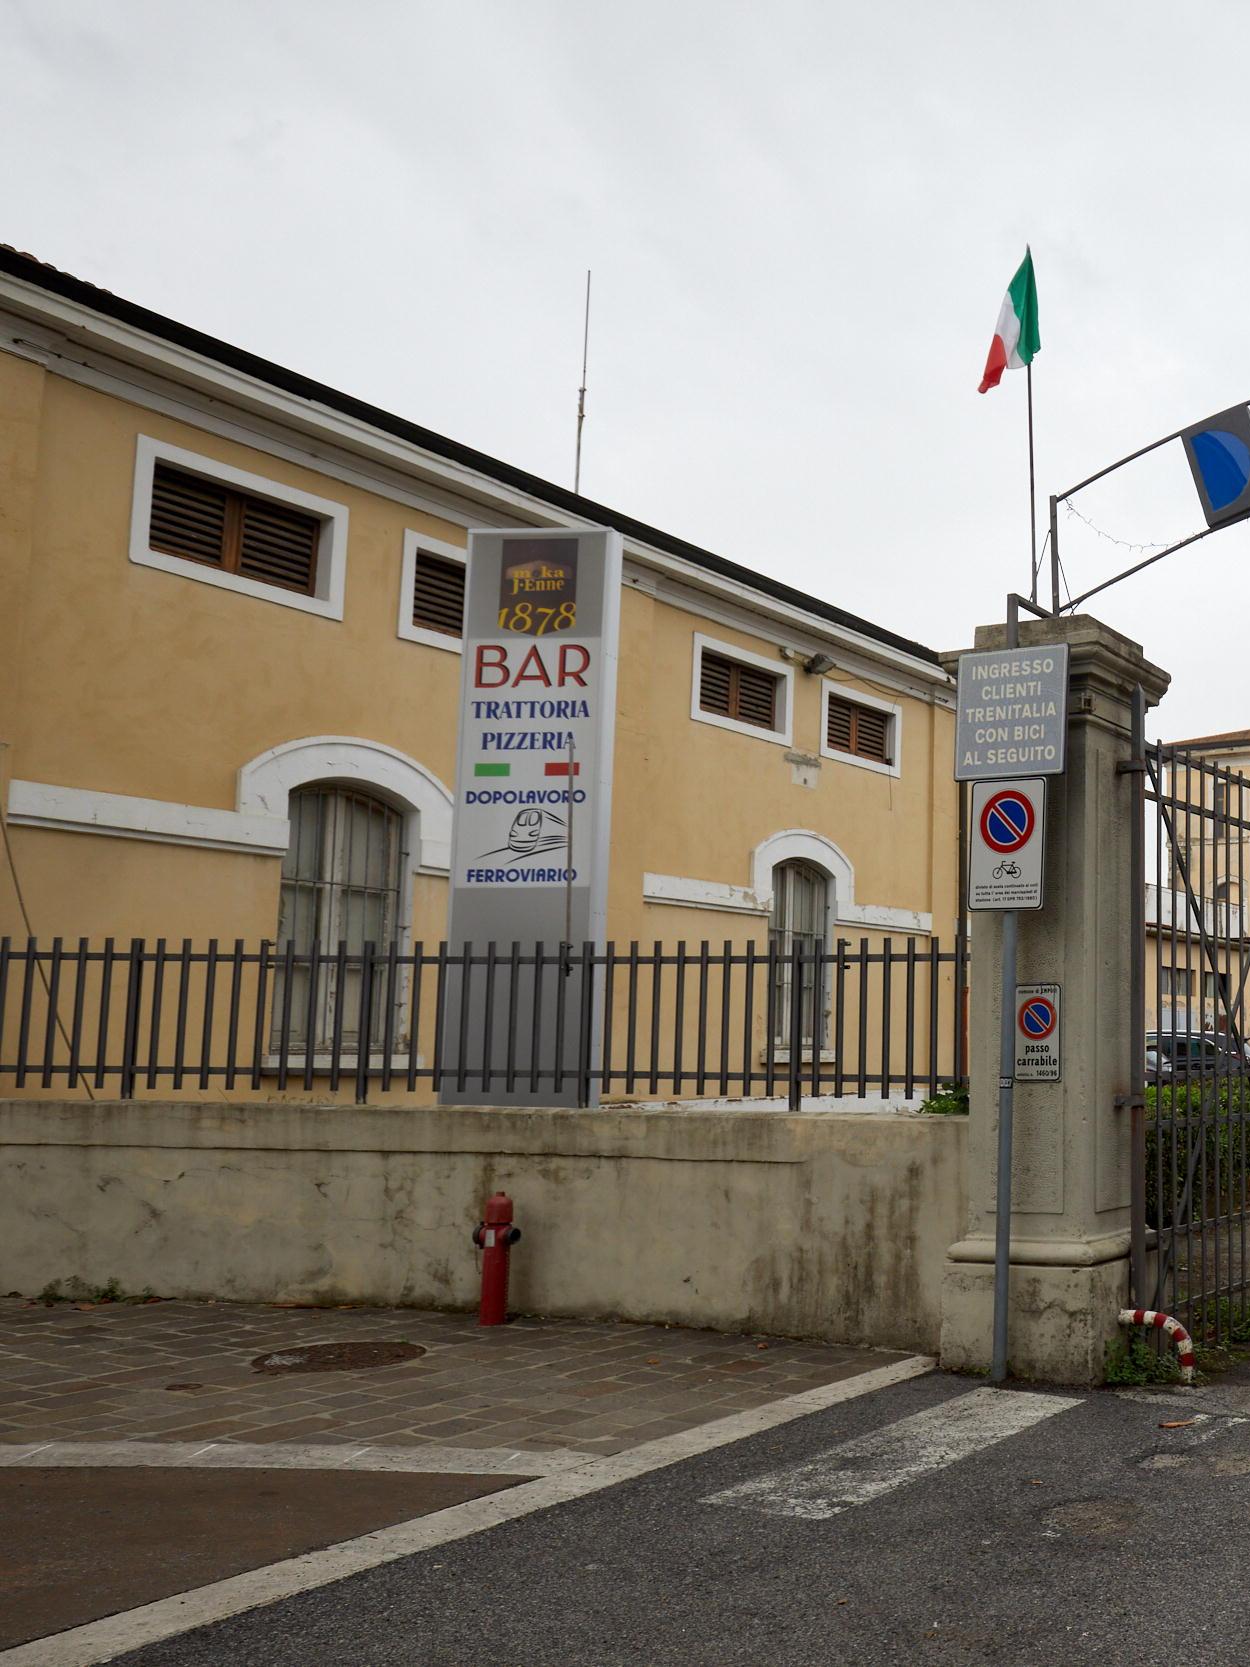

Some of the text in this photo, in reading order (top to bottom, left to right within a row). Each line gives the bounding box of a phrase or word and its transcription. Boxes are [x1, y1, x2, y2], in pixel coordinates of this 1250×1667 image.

[498, 602, 576, 637] 1878
[474, 644, 591, 688] BAR
[972, 659, 1054, 681] INGRESSO
[981, 681, 1041, 700] CLIENTI
[472, 700, 590, 720] TRATTORIA
[966, 702, 1056, 723] TRENITALIA
[481, 731, 576, 751] PIZZERIA
[975, 724, 1044, 744] CON BICI
[963, 745, 1055, 766] AL SEGUITO
[465, 790, 586, 804] DOPOLAVORO
[466, 868, 577, 883] FERROVIARIO
[1025, 1045, 1050, 1055] passo
[1017, 1055, 1058, 1066] carrabile
